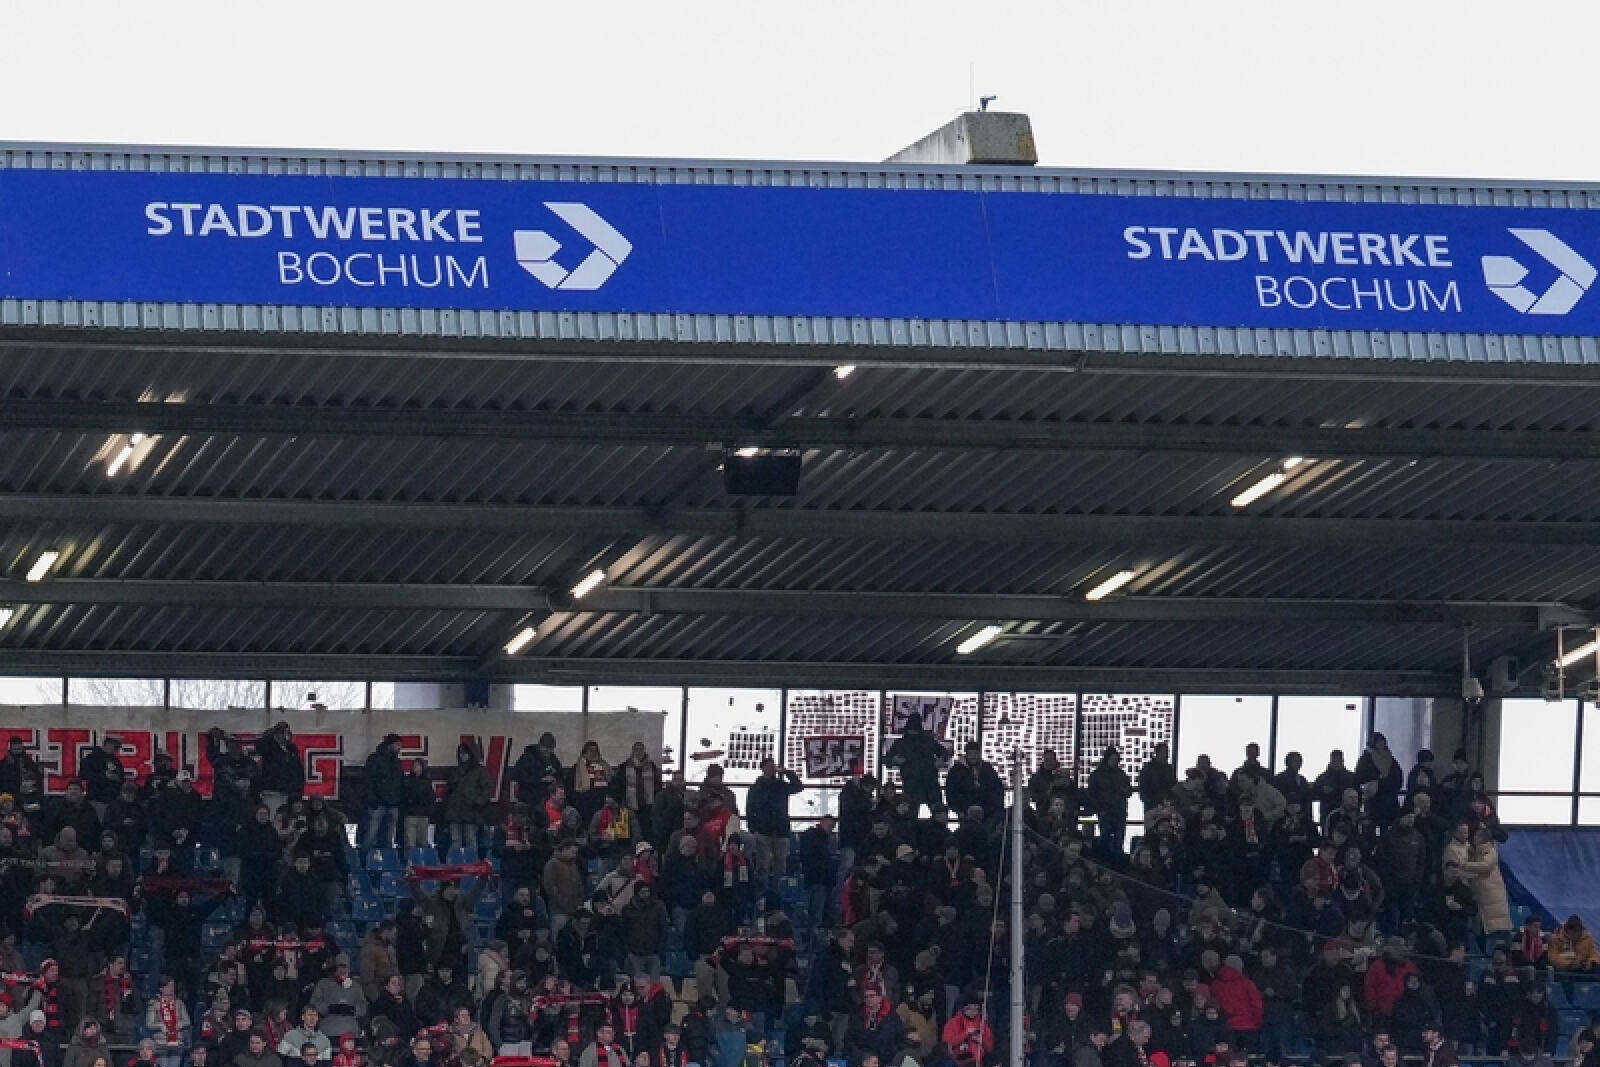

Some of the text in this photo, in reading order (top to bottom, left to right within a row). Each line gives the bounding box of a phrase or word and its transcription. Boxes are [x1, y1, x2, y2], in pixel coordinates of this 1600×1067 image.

[145, 202, 484, 243] STADTWERKE
[1123, 226, 1453, 268] STADTWERKE
[278, 251, 489, 289] BOCHUM
[1255, 275, 1463, 313] BOCHUM
